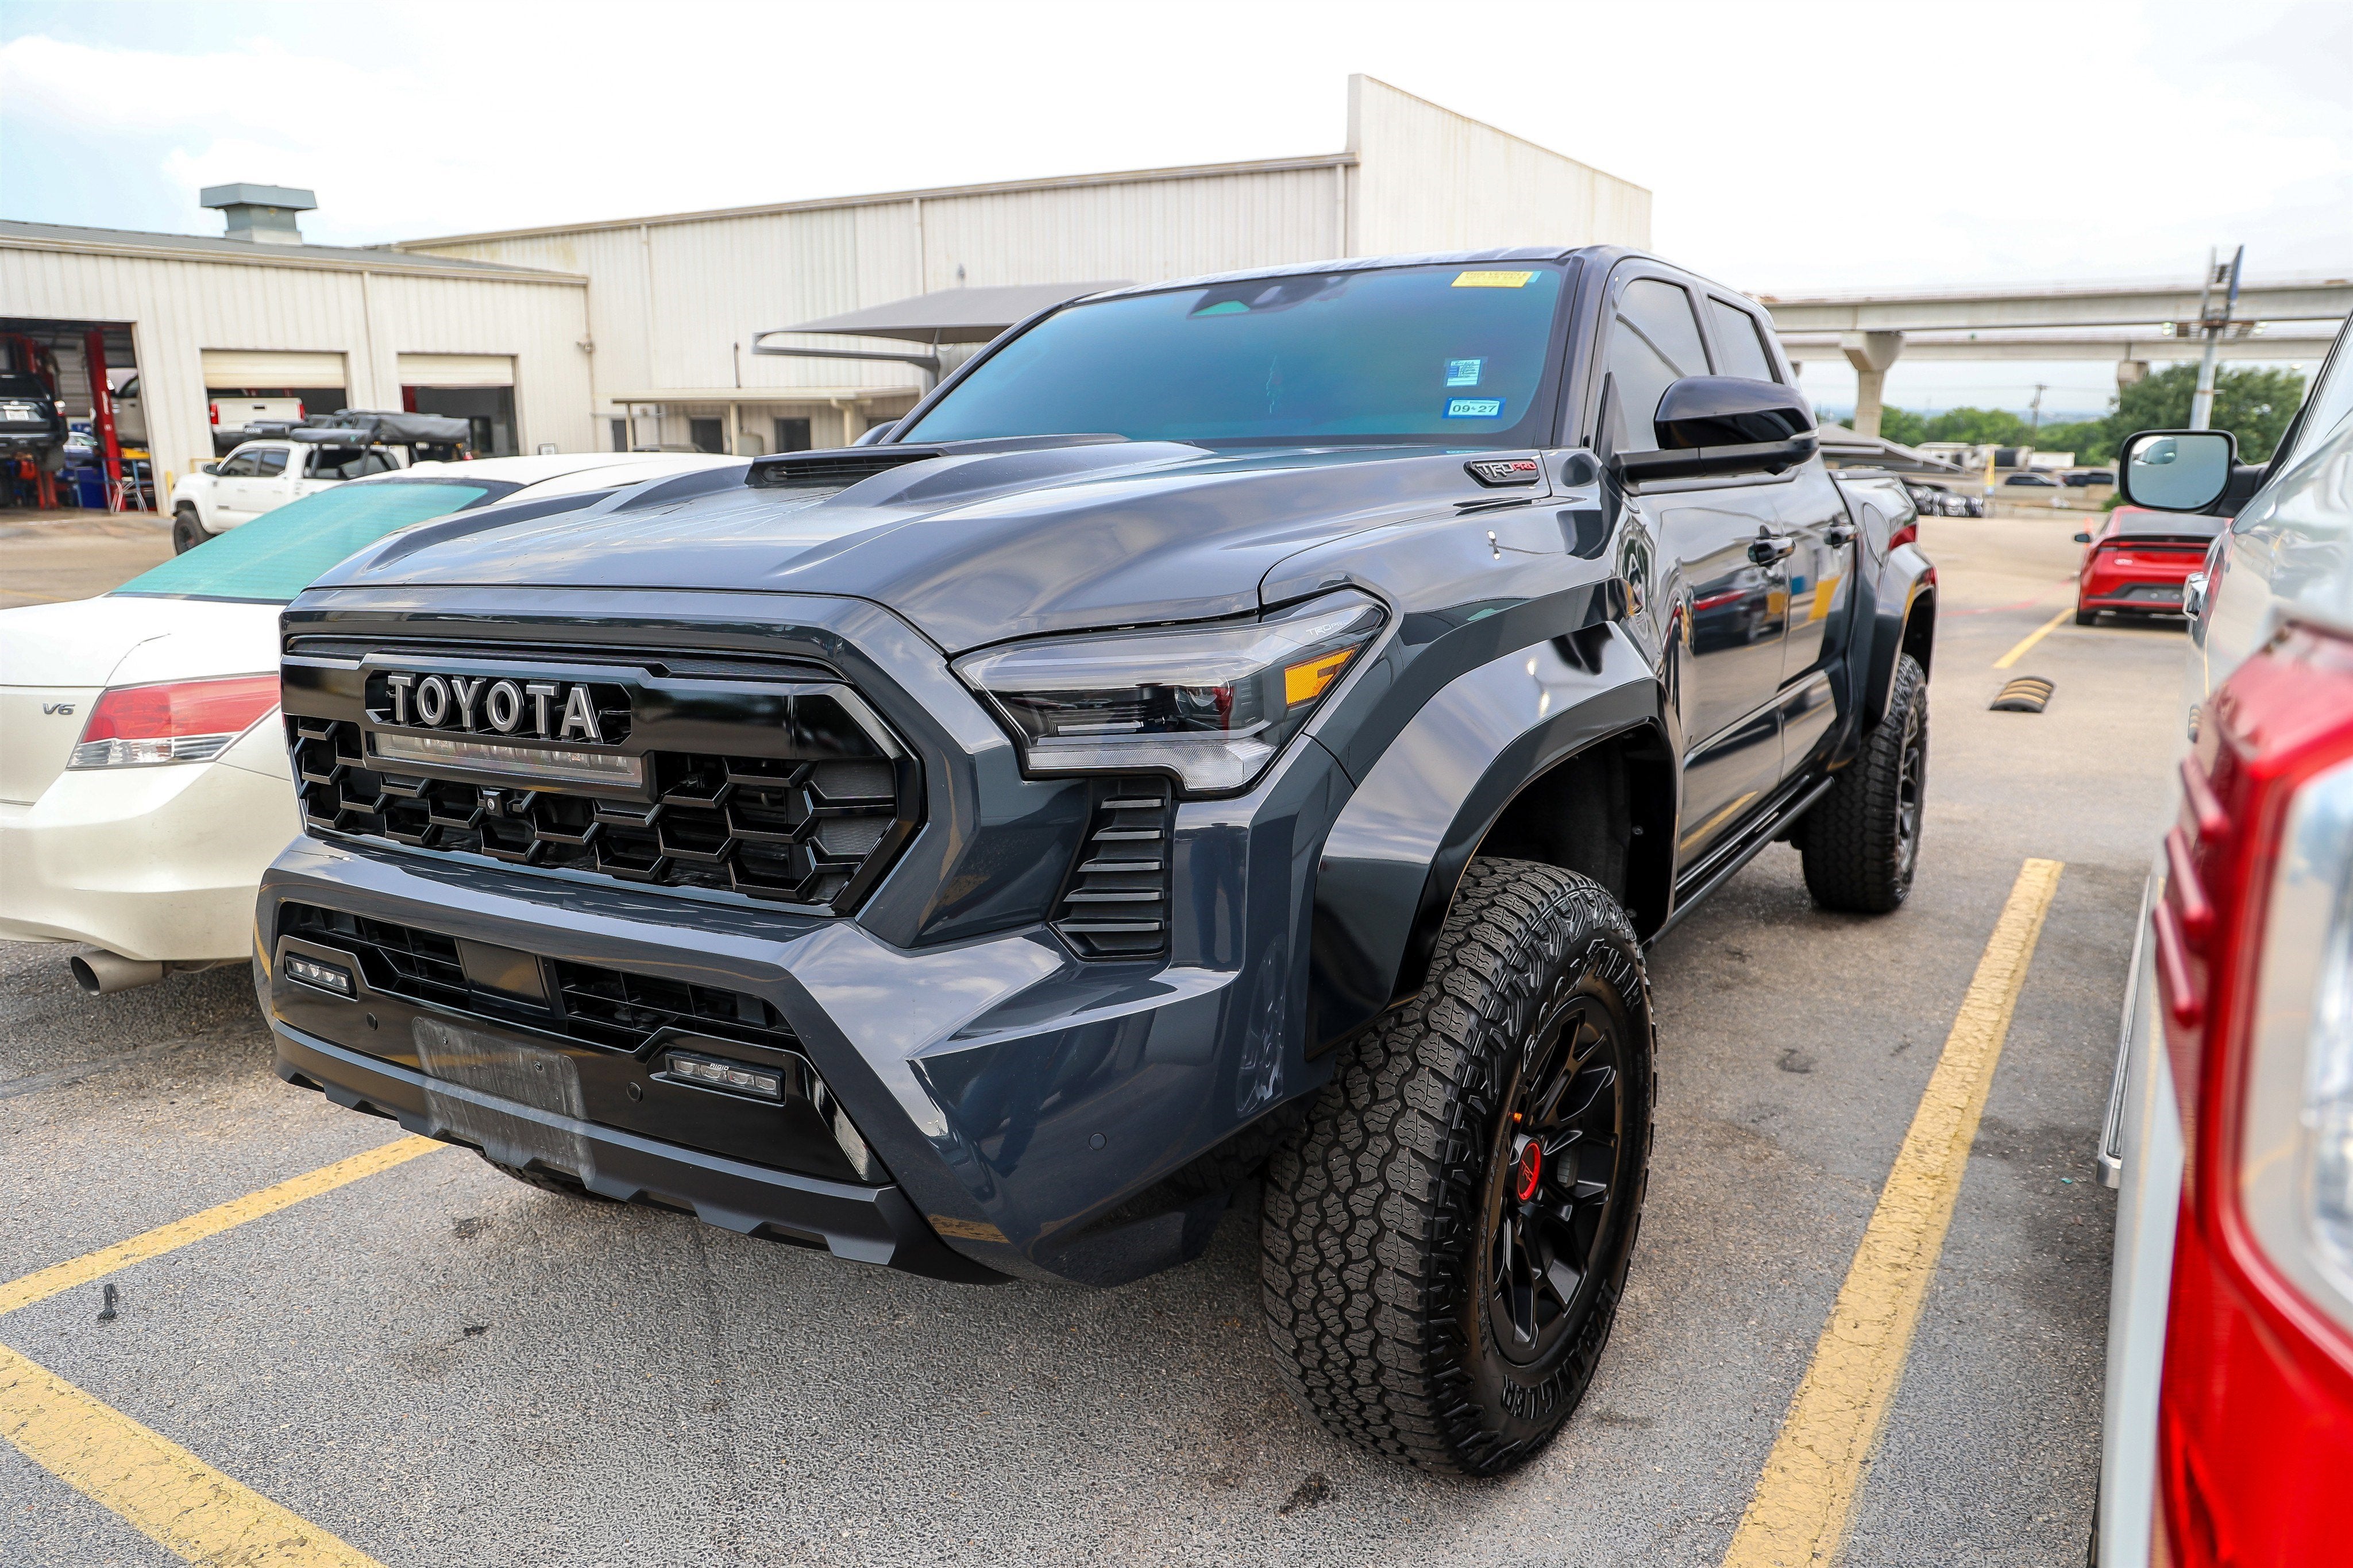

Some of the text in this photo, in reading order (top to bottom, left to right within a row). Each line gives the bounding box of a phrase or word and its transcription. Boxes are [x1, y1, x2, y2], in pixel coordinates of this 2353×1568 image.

[1475, 462, 1537, 478] TRD PRO
[1305, 624, 1332, 636] TRD
[43, 703, 76, 715] V6
[388, 673, 602, 742] TOYOTA
[1500, 1279, 1618, 1420] WRANGLER
